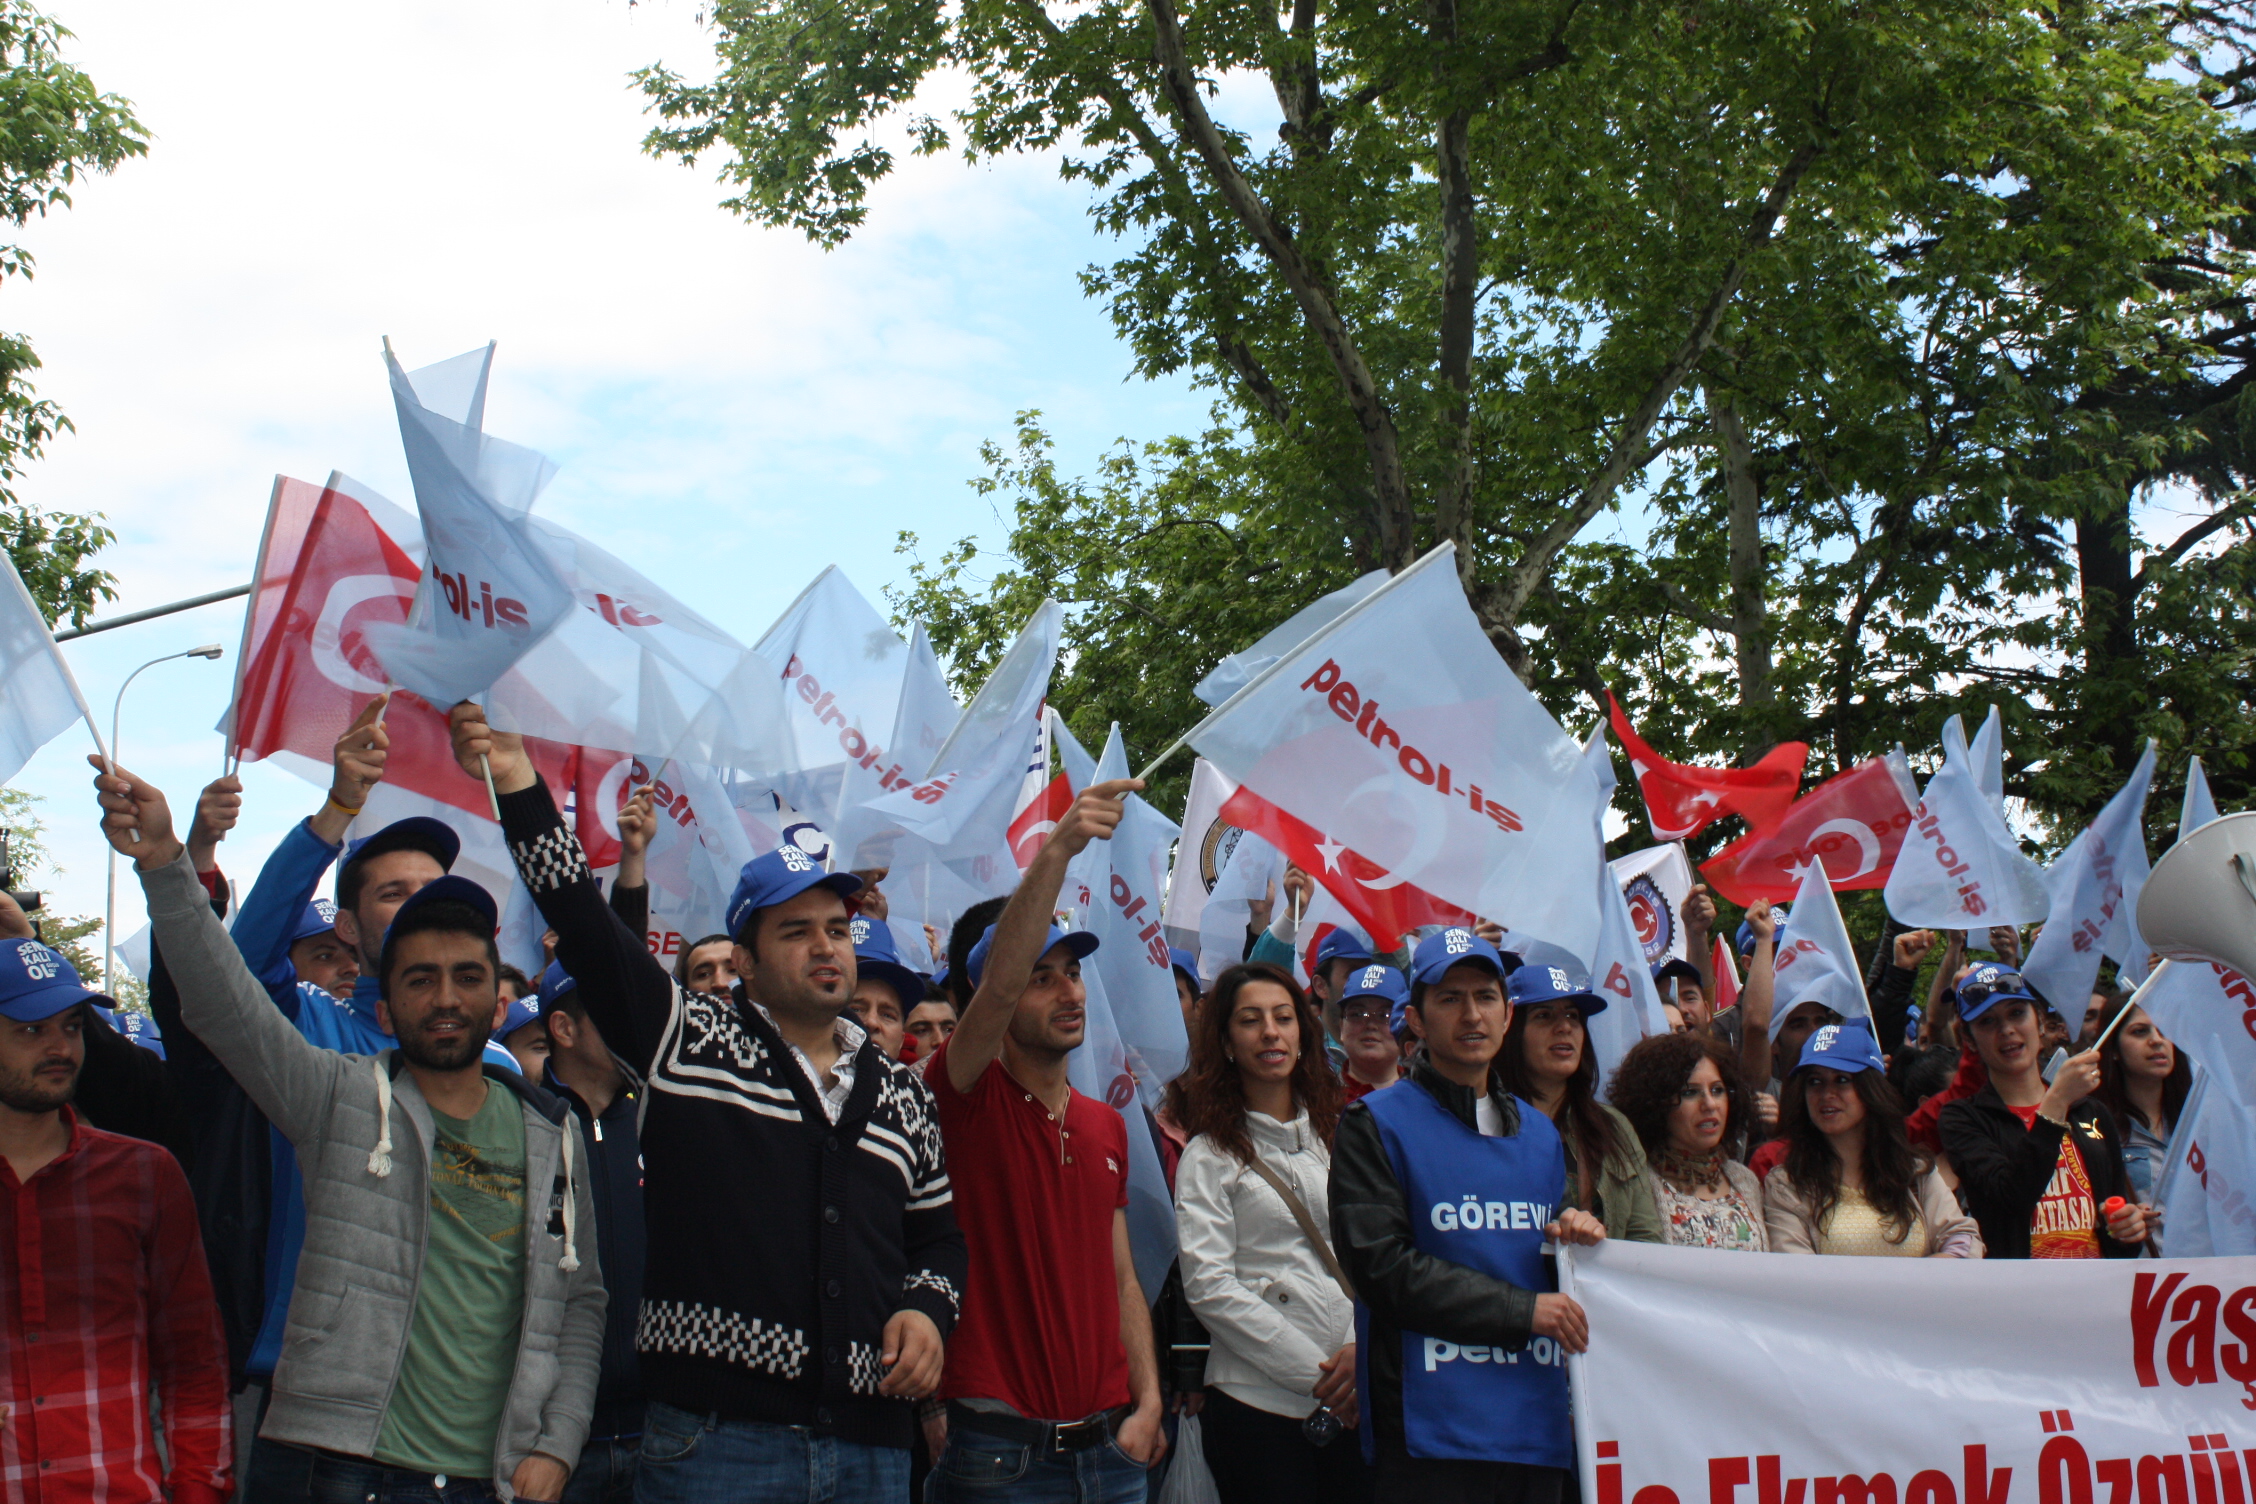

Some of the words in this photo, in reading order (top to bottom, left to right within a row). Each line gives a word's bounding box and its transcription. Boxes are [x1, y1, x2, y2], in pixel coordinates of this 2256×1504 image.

[432, 562, 531, 648] ol-iş
[1300, 657, 1524, 834] petrol-iş
[1913, 801, 1988, 917] etrol-iş
[787, 861, 811, 872] OL
[1110, 863, 1171, 970] ol-iş
[648, 931, 682, 955] SE
[1445, 936, 1468, 945] KALI
[1446, 944, 1467, 955] OL
[1645, 942, 1661, 955] 52
[21, 952, 52, 966] KALI
[27, 964, 56, 981] OL
[1363, 972, 1381, 980] KALI
[1361, 980, 1375, 989] OL
[1552, 980, 1569, 992] OL
[1813, 1041, 1828, 1052] OL
[2064, 1147, 2091, 1190] ATASARAY
[2130, 1272, 2256, 1411] Yaş
